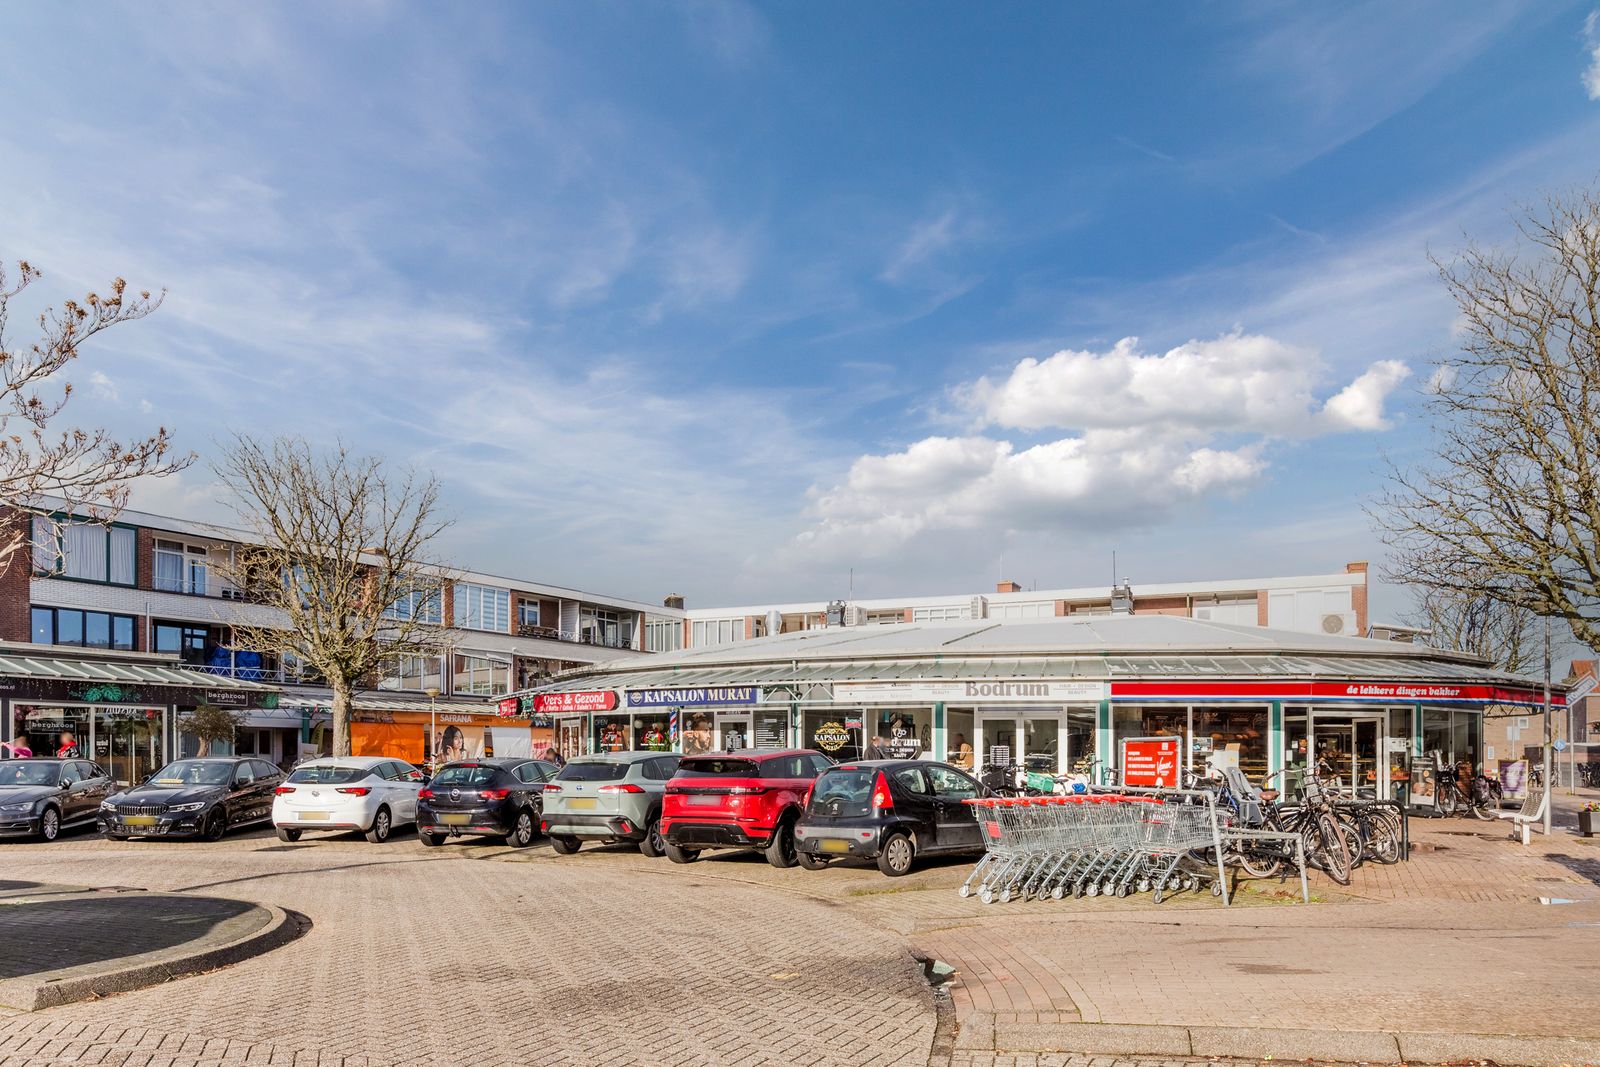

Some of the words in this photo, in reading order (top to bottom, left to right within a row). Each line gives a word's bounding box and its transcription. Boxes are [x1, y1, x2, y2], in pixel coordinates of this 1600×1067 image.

[965, 680, 1049, 696] Bodrum
[1346, 685, 1358, 694] de
[1360, 685, 1394, 695] lekkere
[1396, 686, 1427, 697] dingen
[1429, 686, 1460, 696] bakker
[543, 695, 562, 705] Vers
[564, 694, 573, 704] &
[574, 692, 605, 703] Gezond
[644, 689, 705, 703] KAPSALON
[707, 687, 752, 701] MURAT
[440, 714, 472, 723] SAFRANA
[814, 734, 850, 742] KAPSALON
[891, 737, 921, 747] drum
